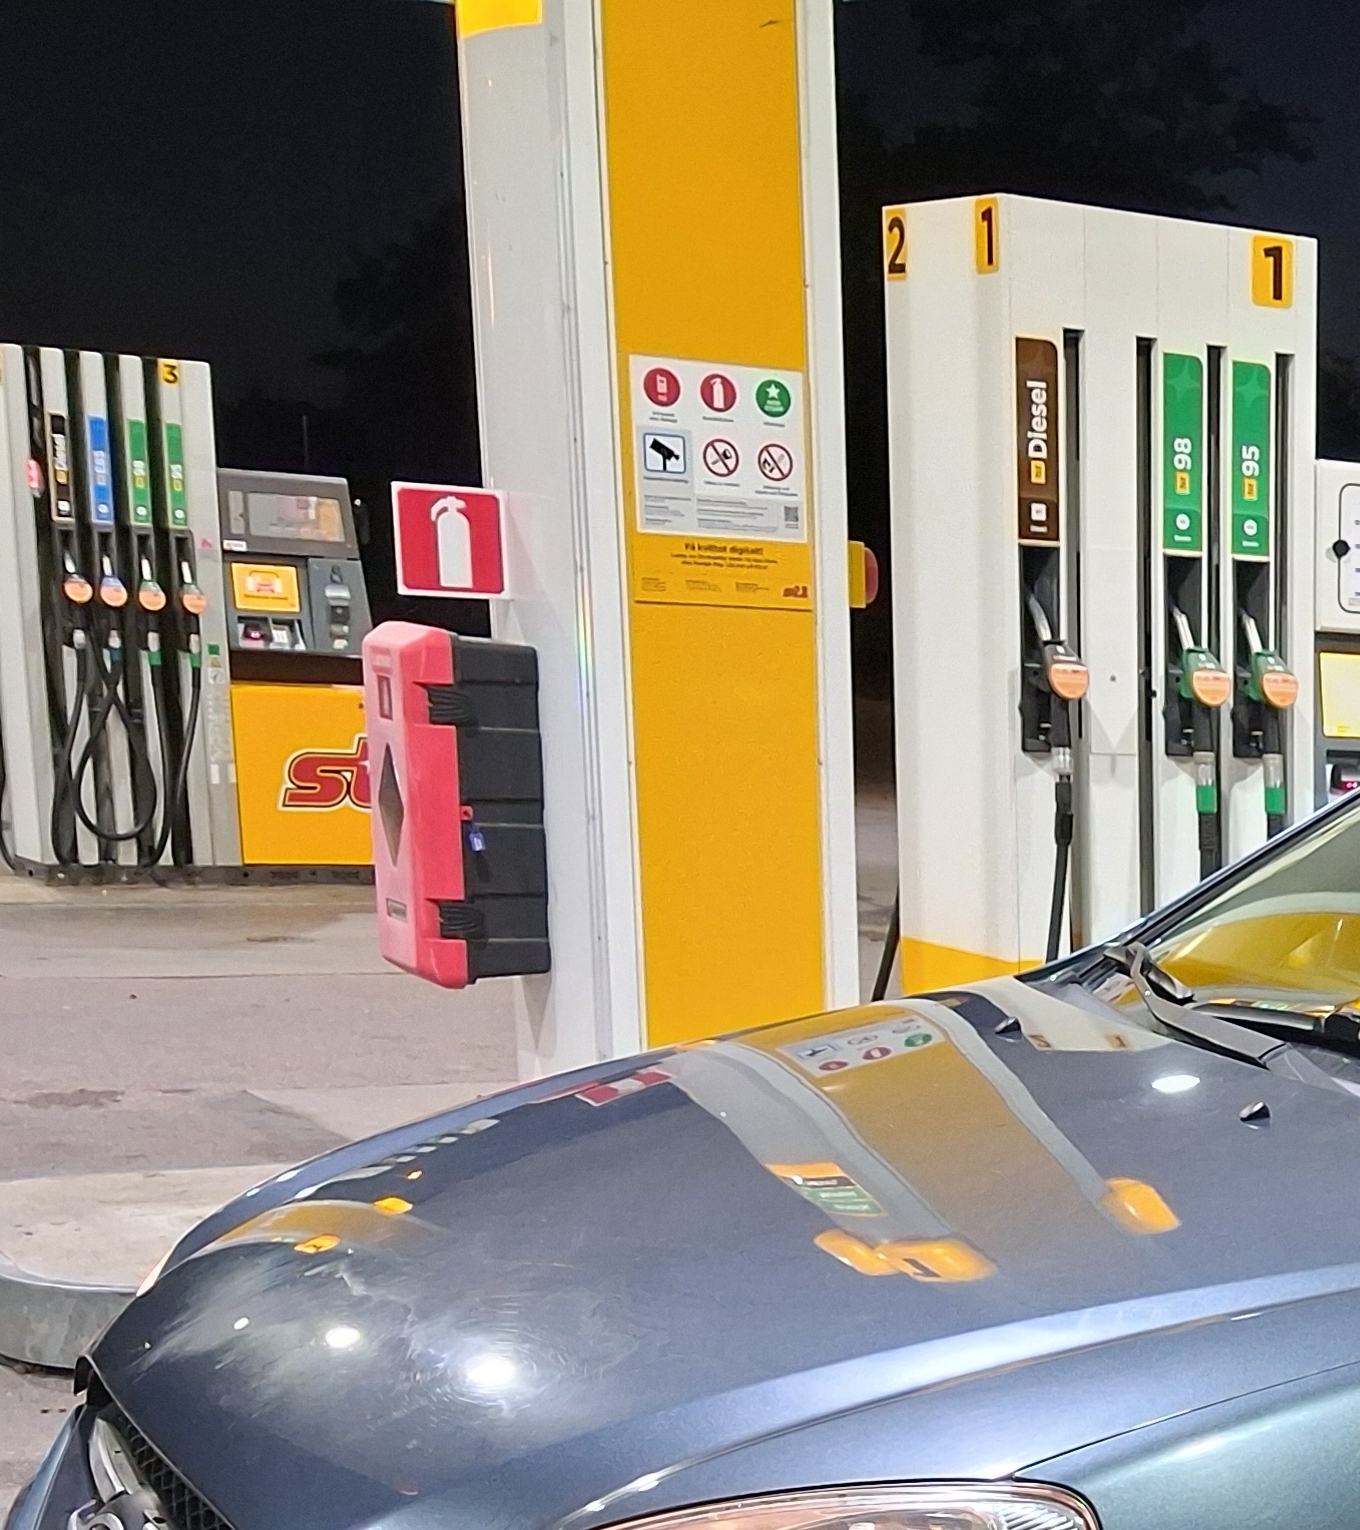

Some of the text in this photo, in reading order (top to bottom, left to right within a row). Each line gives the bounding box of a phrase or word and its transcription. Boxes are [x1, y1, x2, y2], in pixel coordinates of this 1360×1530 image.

[887, 216, 907, 275] 2
[980, 205, 994, 266] 1
[1262, 244, 1283, 301] 1
[162, 364, 179, 384] 3
[1026, 379, 1048, 459] Diesel
[1173, 437, 1192, 470] 98
[1241, 445, 1260, 477] 95
